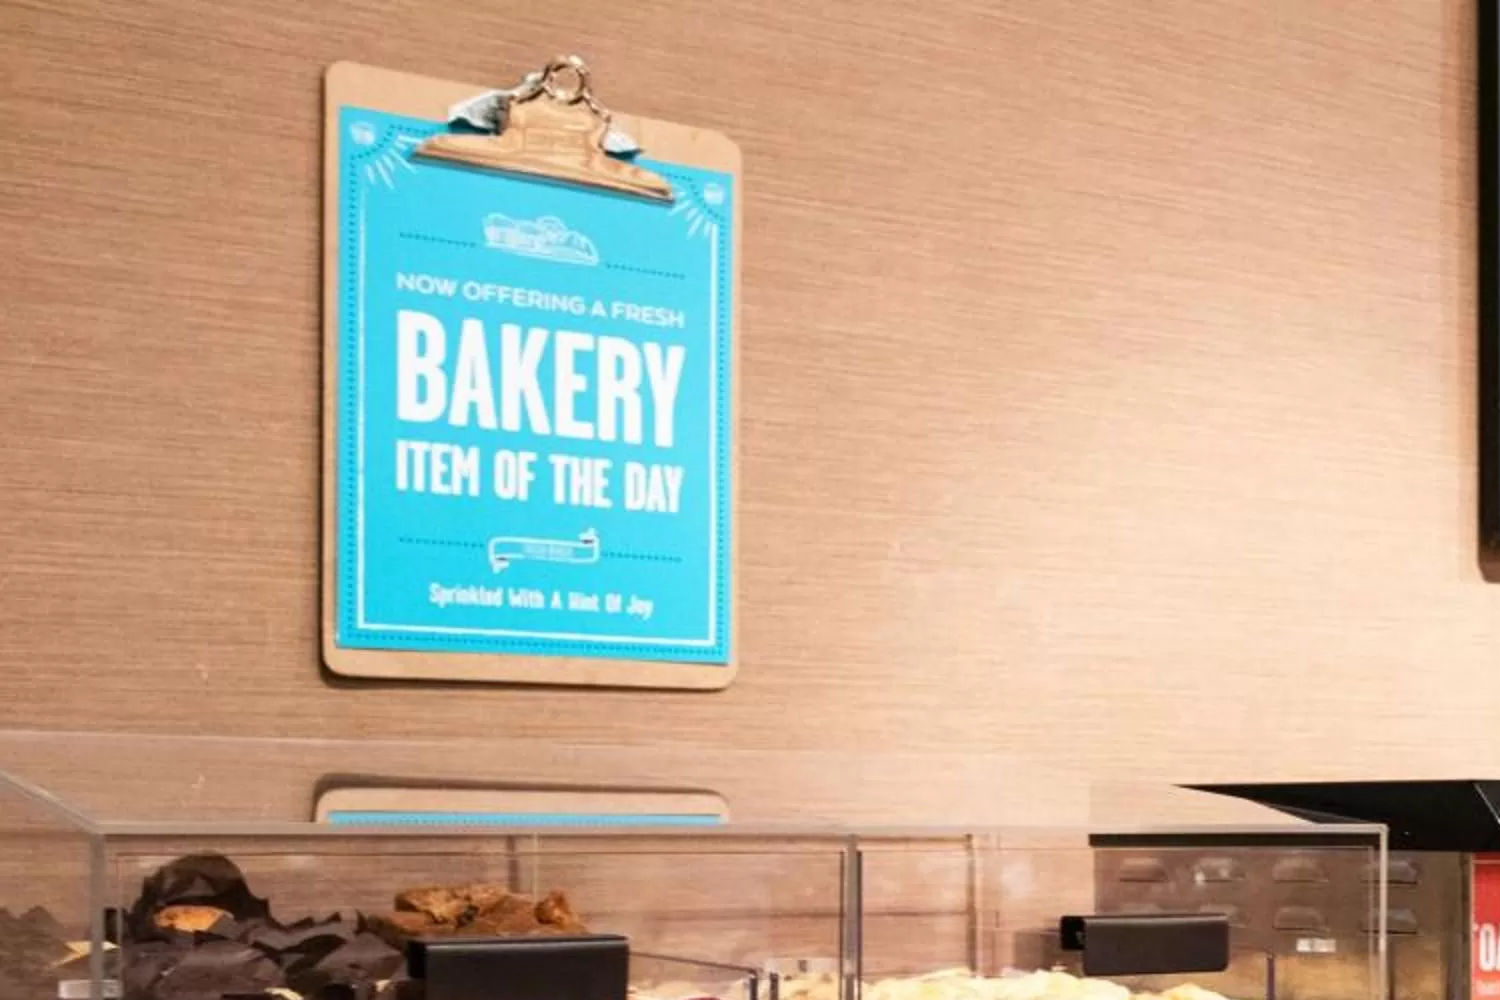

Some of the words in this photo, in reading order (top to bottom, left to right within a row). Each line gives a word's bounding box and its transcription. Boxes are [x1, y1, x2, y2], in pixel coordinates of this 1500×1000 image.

[396, 271, 457, 298] NOW
[463, 280, 585, 316] OFFERING
[591, 299, 607, 318] A
[611, 302, 685, 329] FRESH
[396, 308, 686, 448] BAKERY
[396, 439, 481, 497] ITEM
[493, 448, 538, 502] OF
[549, 453, 613, 509] THE
[623, 461, 685, 514] DAY
[550, 590, 562, 610] A
[626, 594, 654, 621] Joy
